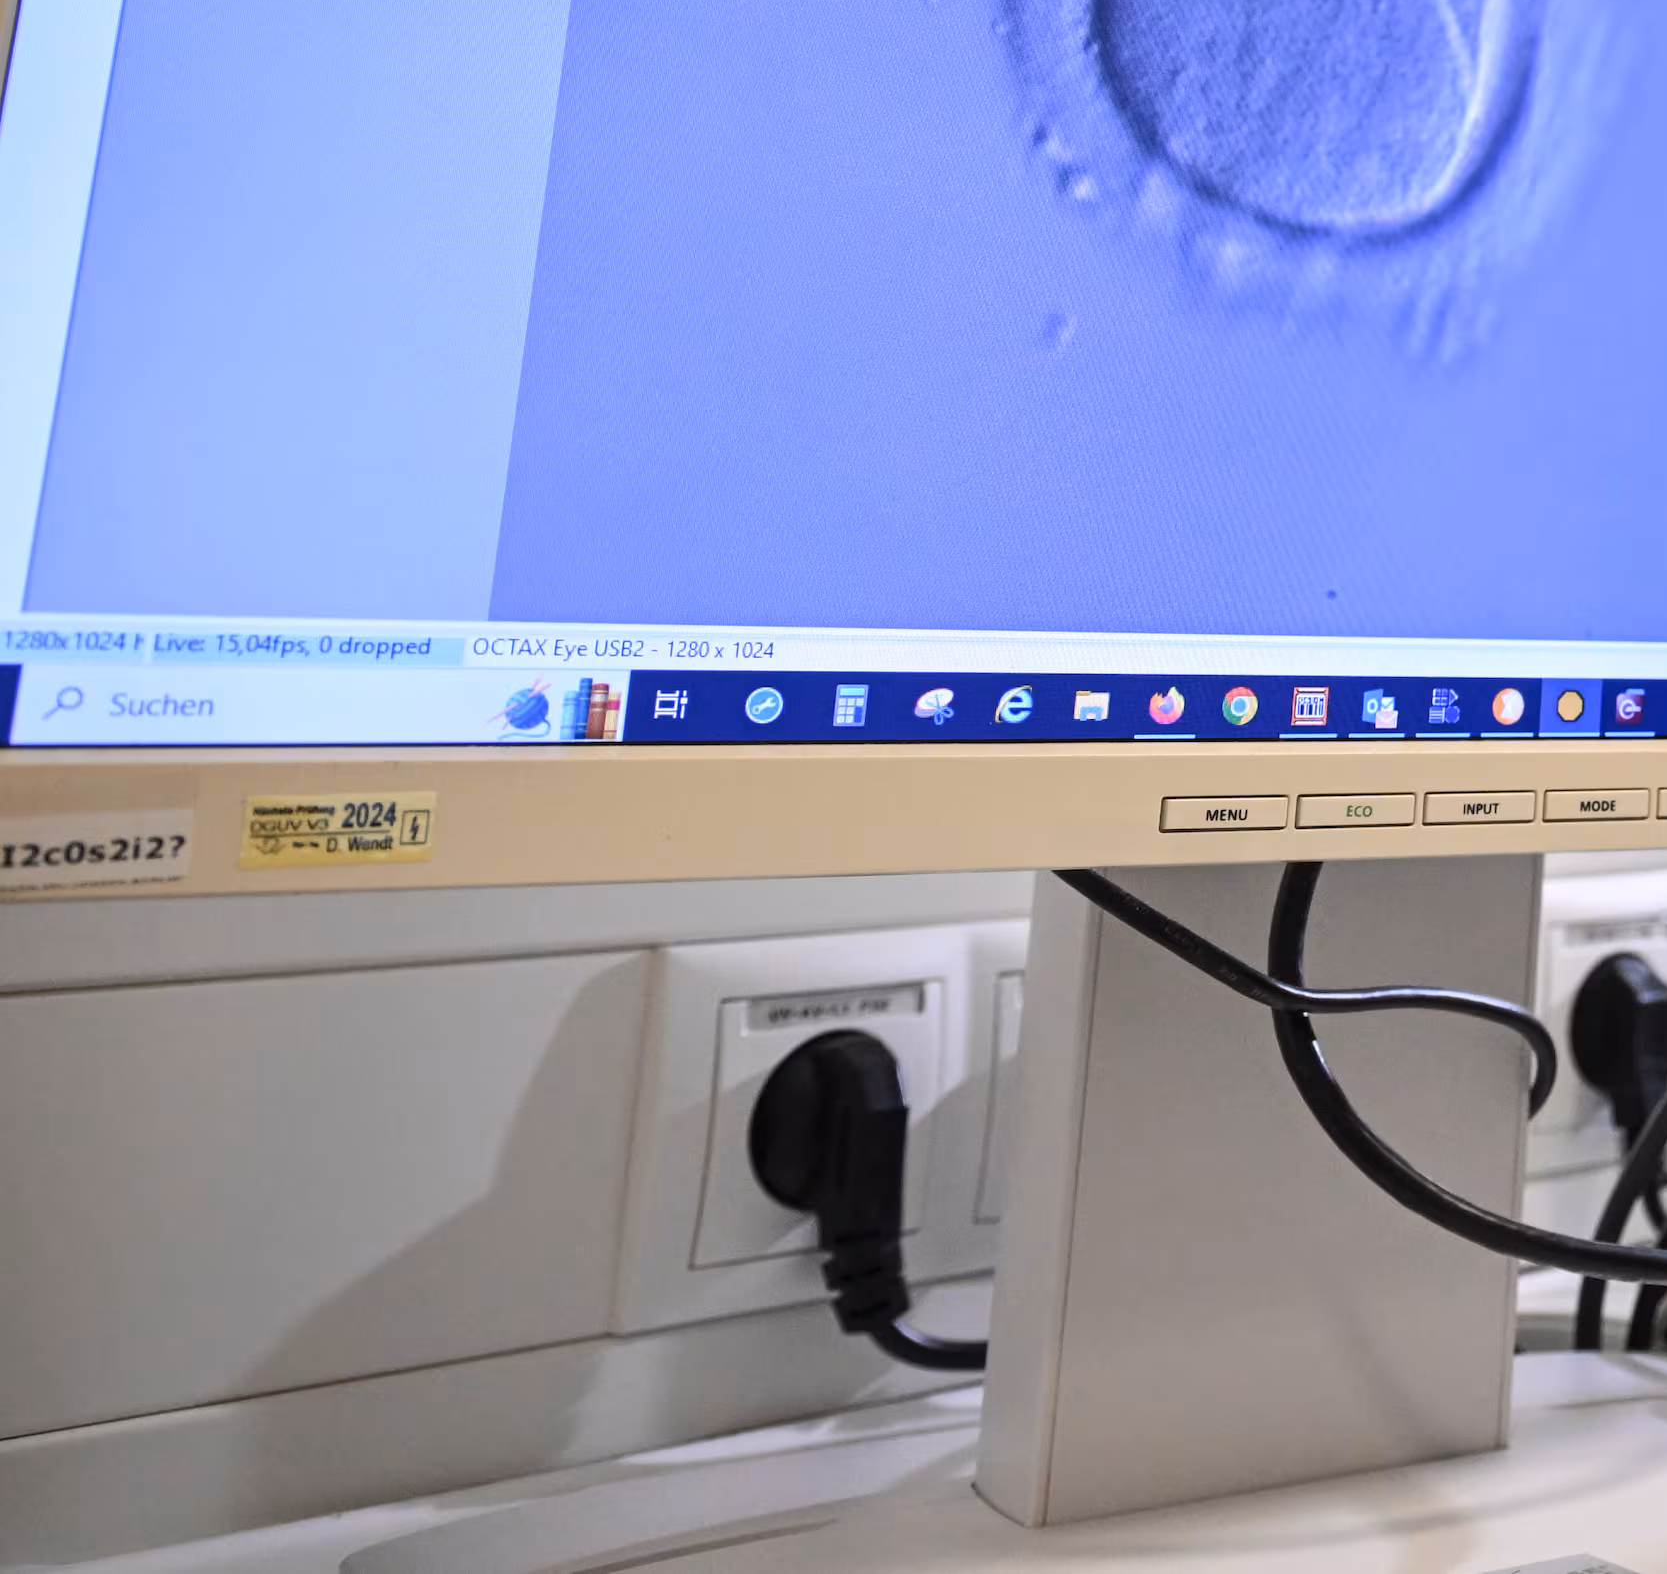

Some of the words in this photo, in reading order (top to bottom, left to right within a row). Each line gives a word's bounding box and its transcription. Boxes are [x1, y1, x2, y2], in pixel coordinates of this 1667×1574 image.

[154, 633, 205, 653] Live:
[216, 633, 310, 658] 15,04fps,
[319, 635, 333, 654] 0
[339, 636, 432, 660] dropped
[473, 637, 548, 657] OCTAX
[554, 639, 588, 662] Eye
[594, 639, 645, 658] USB2
[667, 640, 710, 659] 1280
[714, 645, 725, 659] x
[733, 642, 775, 659] 1024
[109, 692, 215, 717] Suchen
[1346, 805, 1373, 818] ECO
[1463, 802, 1500, 815] INPUT
[1579, 799, 1617, 813] MODE
[341, 802, 397, 829] 2024
[1205, 808, 1249, 822] MENU
[348, 836, 394, 853] Wendt
